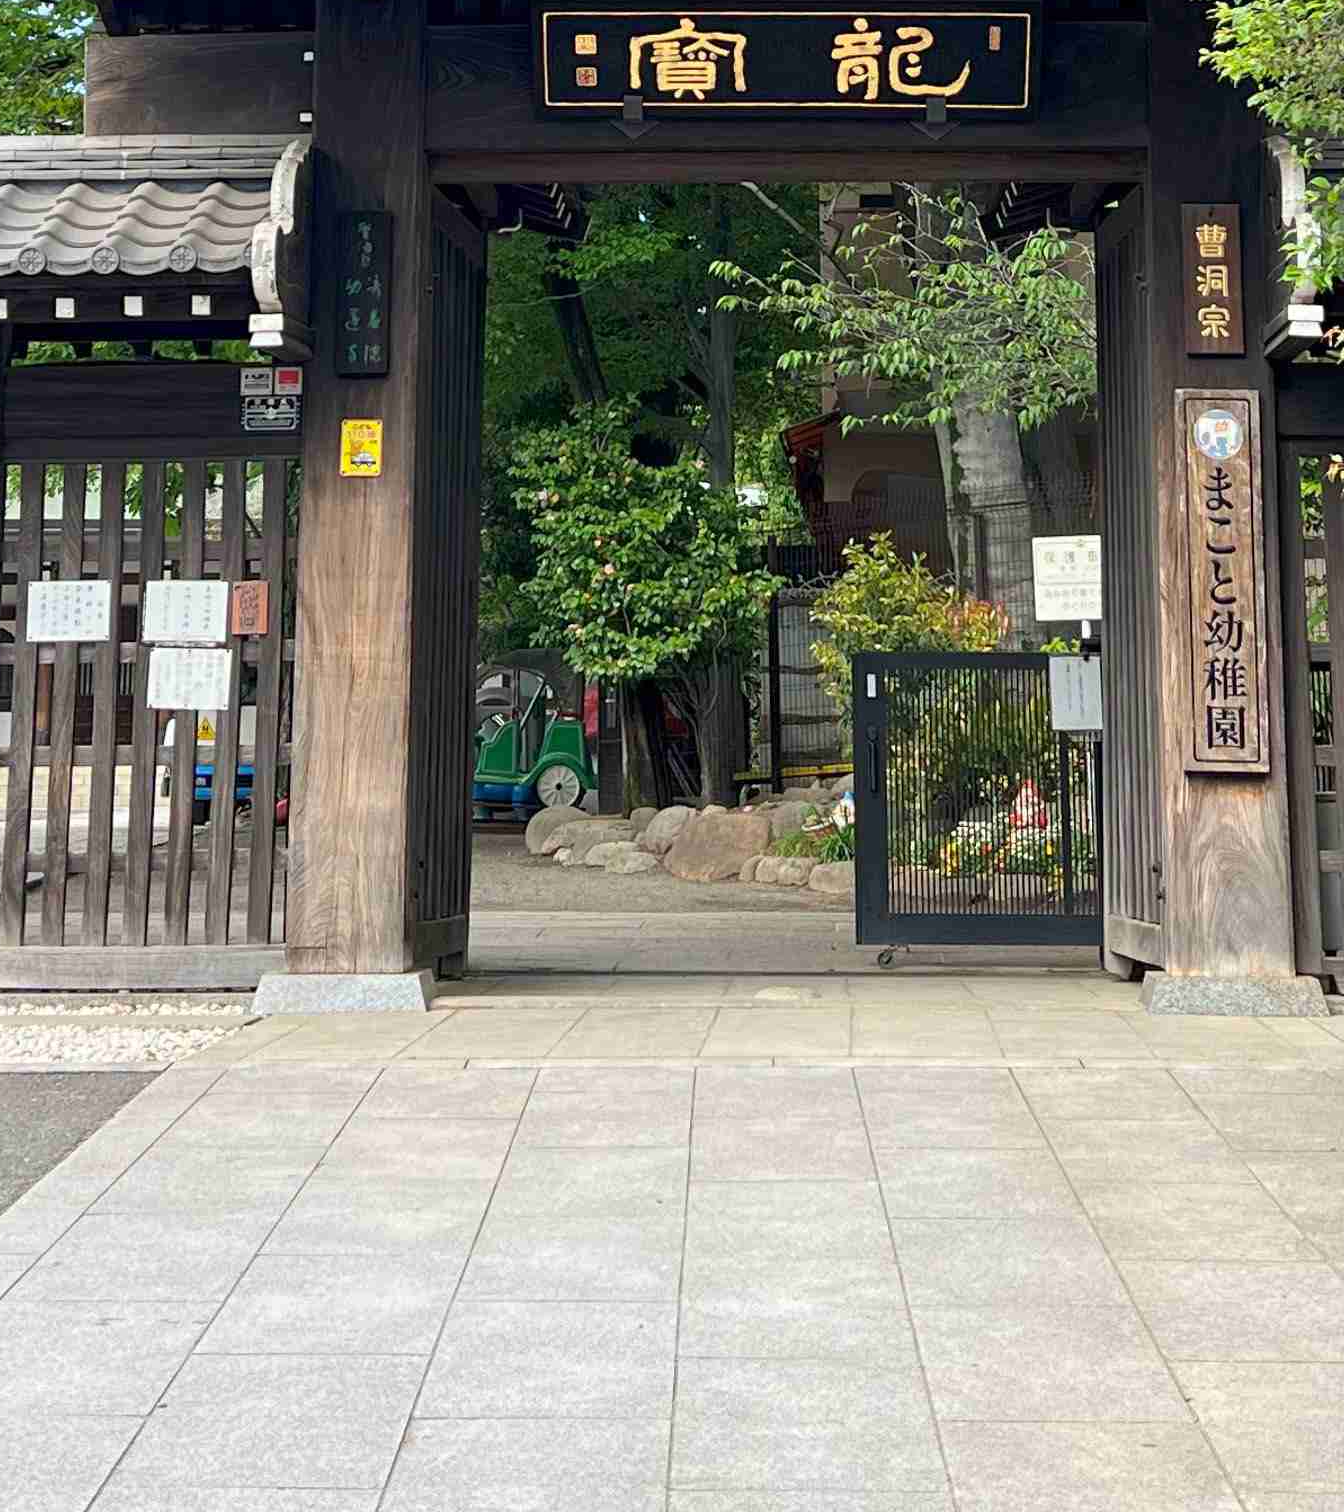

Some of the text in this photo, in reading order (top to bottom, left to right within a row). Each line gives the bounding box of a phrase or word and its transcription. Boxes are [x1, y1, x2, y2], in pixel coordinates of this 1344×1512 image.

[1195, 223, 1231, 338] 曹洞宗
[1203, 467, 1248, 749] まこと幼稚園
